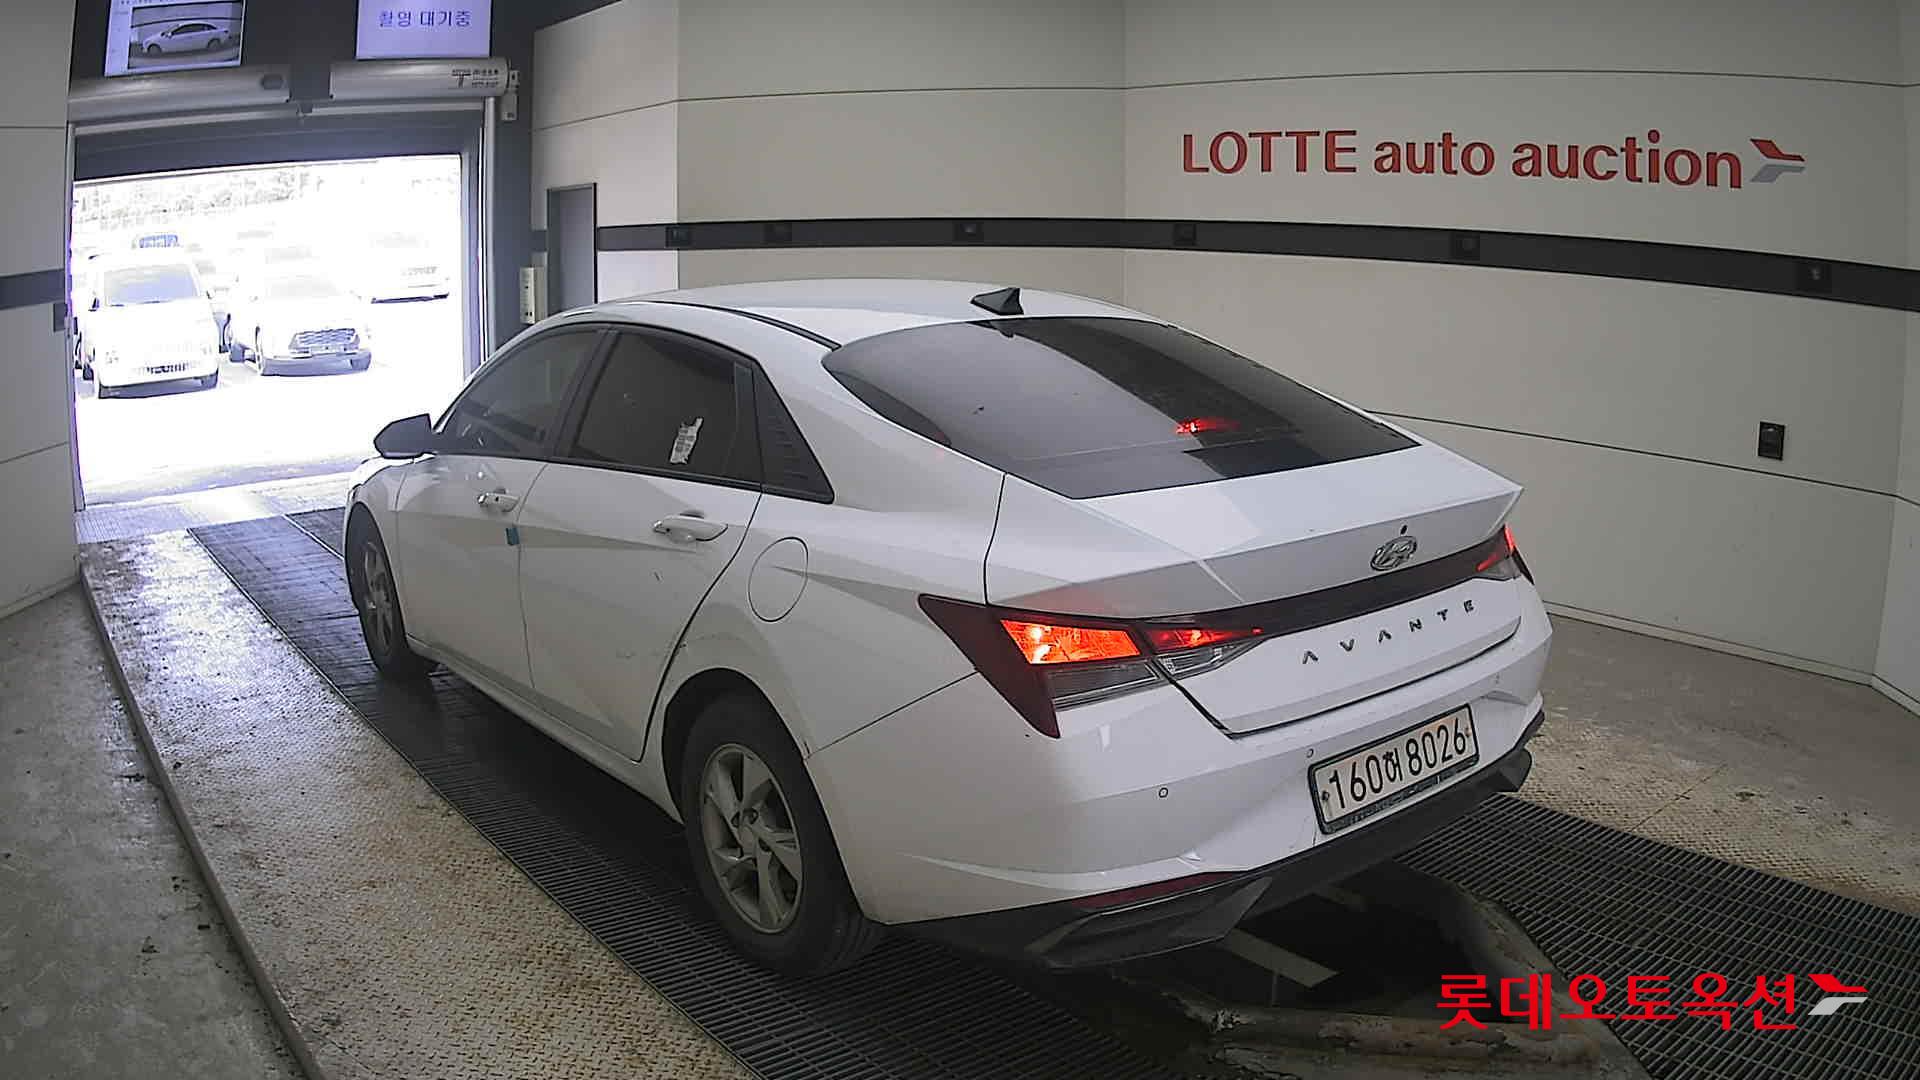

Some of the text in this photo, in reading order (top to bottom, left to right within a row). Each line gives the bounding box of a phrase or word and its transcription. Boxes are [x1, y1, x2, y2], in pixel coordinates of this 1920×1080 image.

[420, 11, 471, 27] 대기중
[1183, 129, 1742, 188] LOTTE auto auction
[1302, 599, 1475, 665] AVANTE
